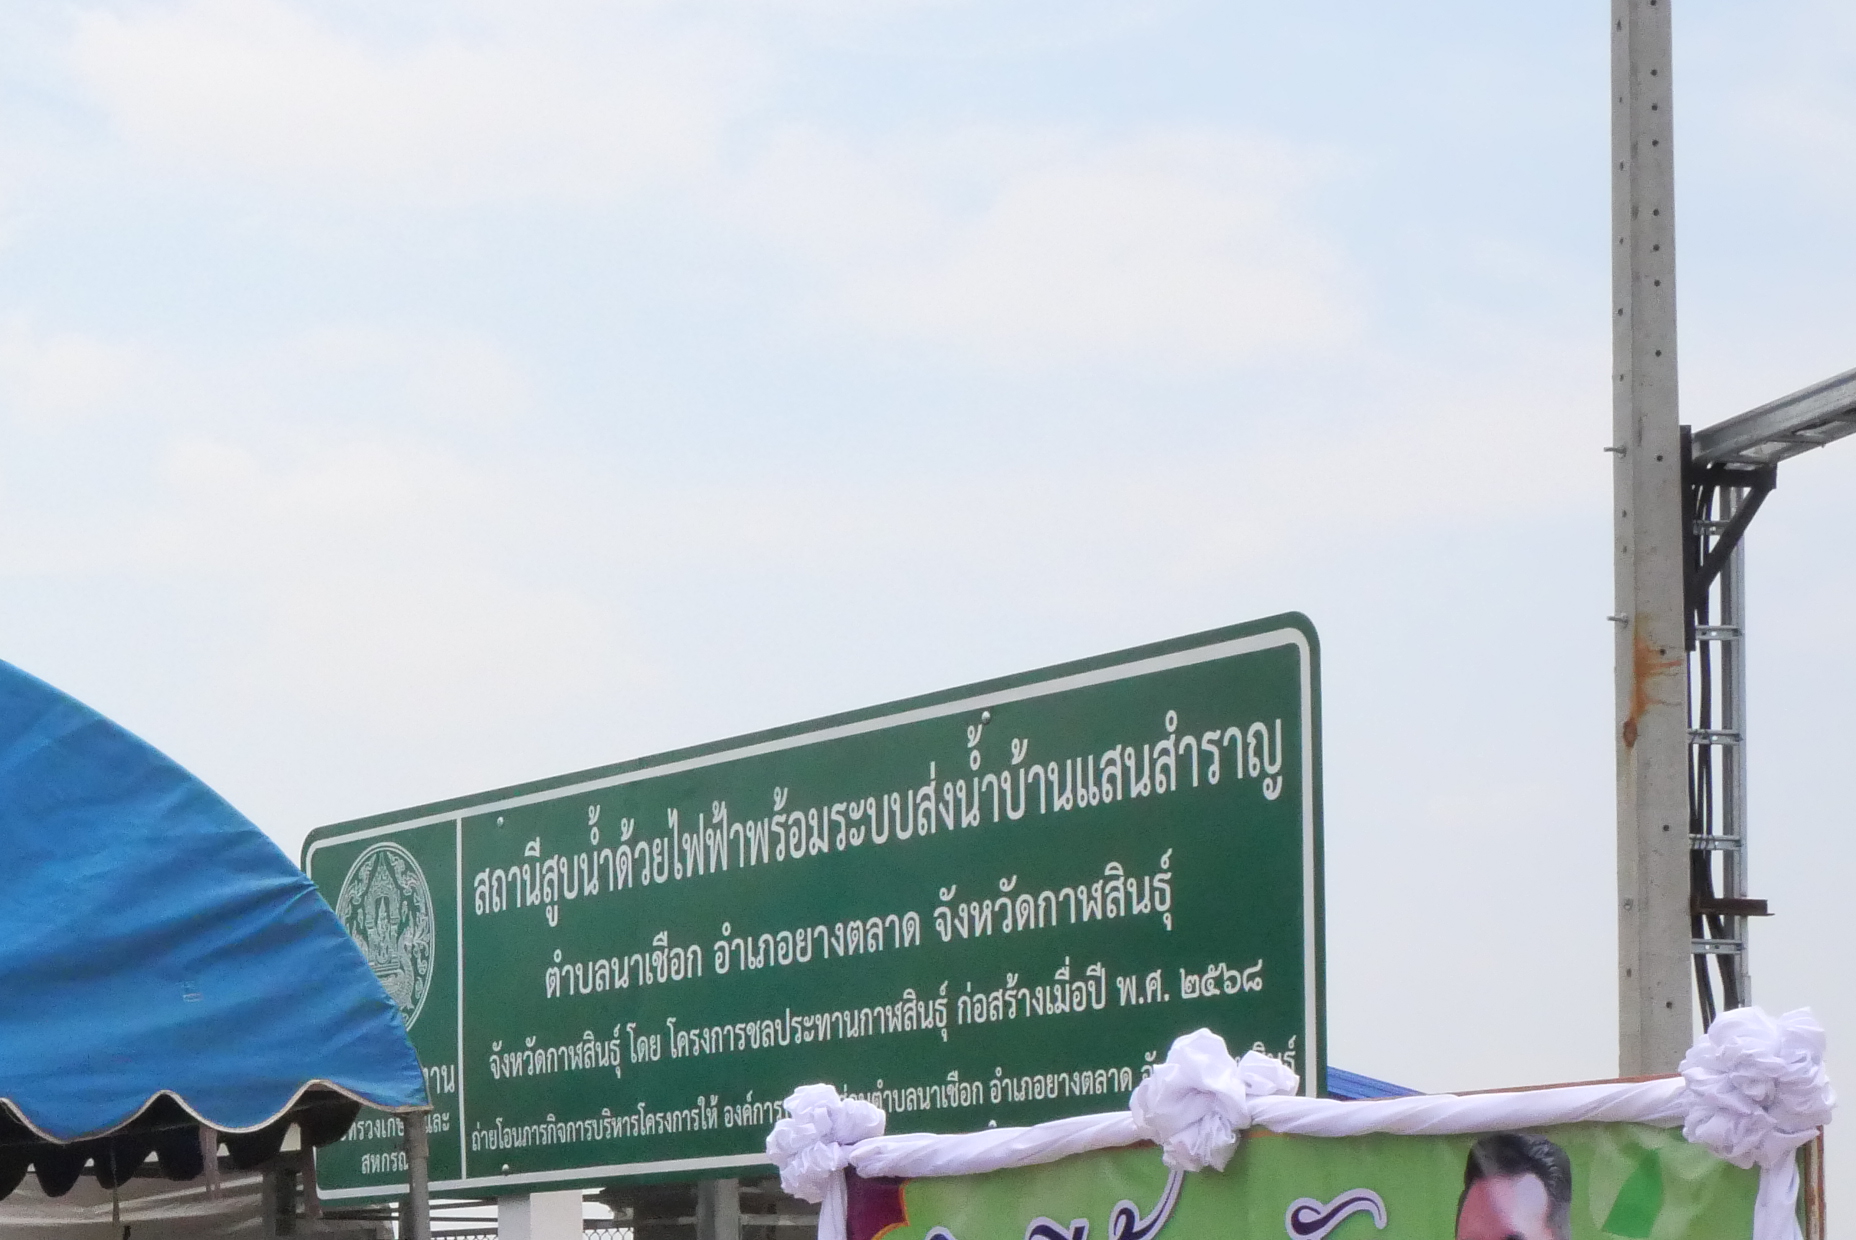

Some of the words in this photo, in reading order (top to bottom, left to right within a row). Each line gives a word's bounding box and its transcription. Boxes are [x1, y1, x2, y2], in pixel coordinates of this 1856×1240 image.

[473, 709, 1283, 927] สถานีสูบน้ำด้วยไฟฟ้าพร้อมระบบส่งน้ำบ้านแสนสำราญ
[545, 930, 703, 999] ตำบลนาเชือก
[713, 911, 921, 976] อำเภอยางตลาด
[933, 848, 1173, 943] จังหวัดกาฬสินธุ์
[488, 1024, 623, 1081] จังหวัดกาฬสินธุ์
[626, 1022, 661, 1064] โดย
[667, 979, 948, 1059] โครงการชลประทานกาฬสินธุ์
[956, 956, 1107, 1025] ก่อสร้างเมื่อปี
[1116, 968, 1171, 1006] พ.ศ.
[1178, 959, 1264, 999] ๒๕๖๘
[361, 1151, 409, 1175] สหกรณ
[470, 1094, 718, 1151] ถ่ายโอนภารกิจการบริหารโครงการให้
[990, 1066, 1133, 1104] อำเภอยางตลาด
